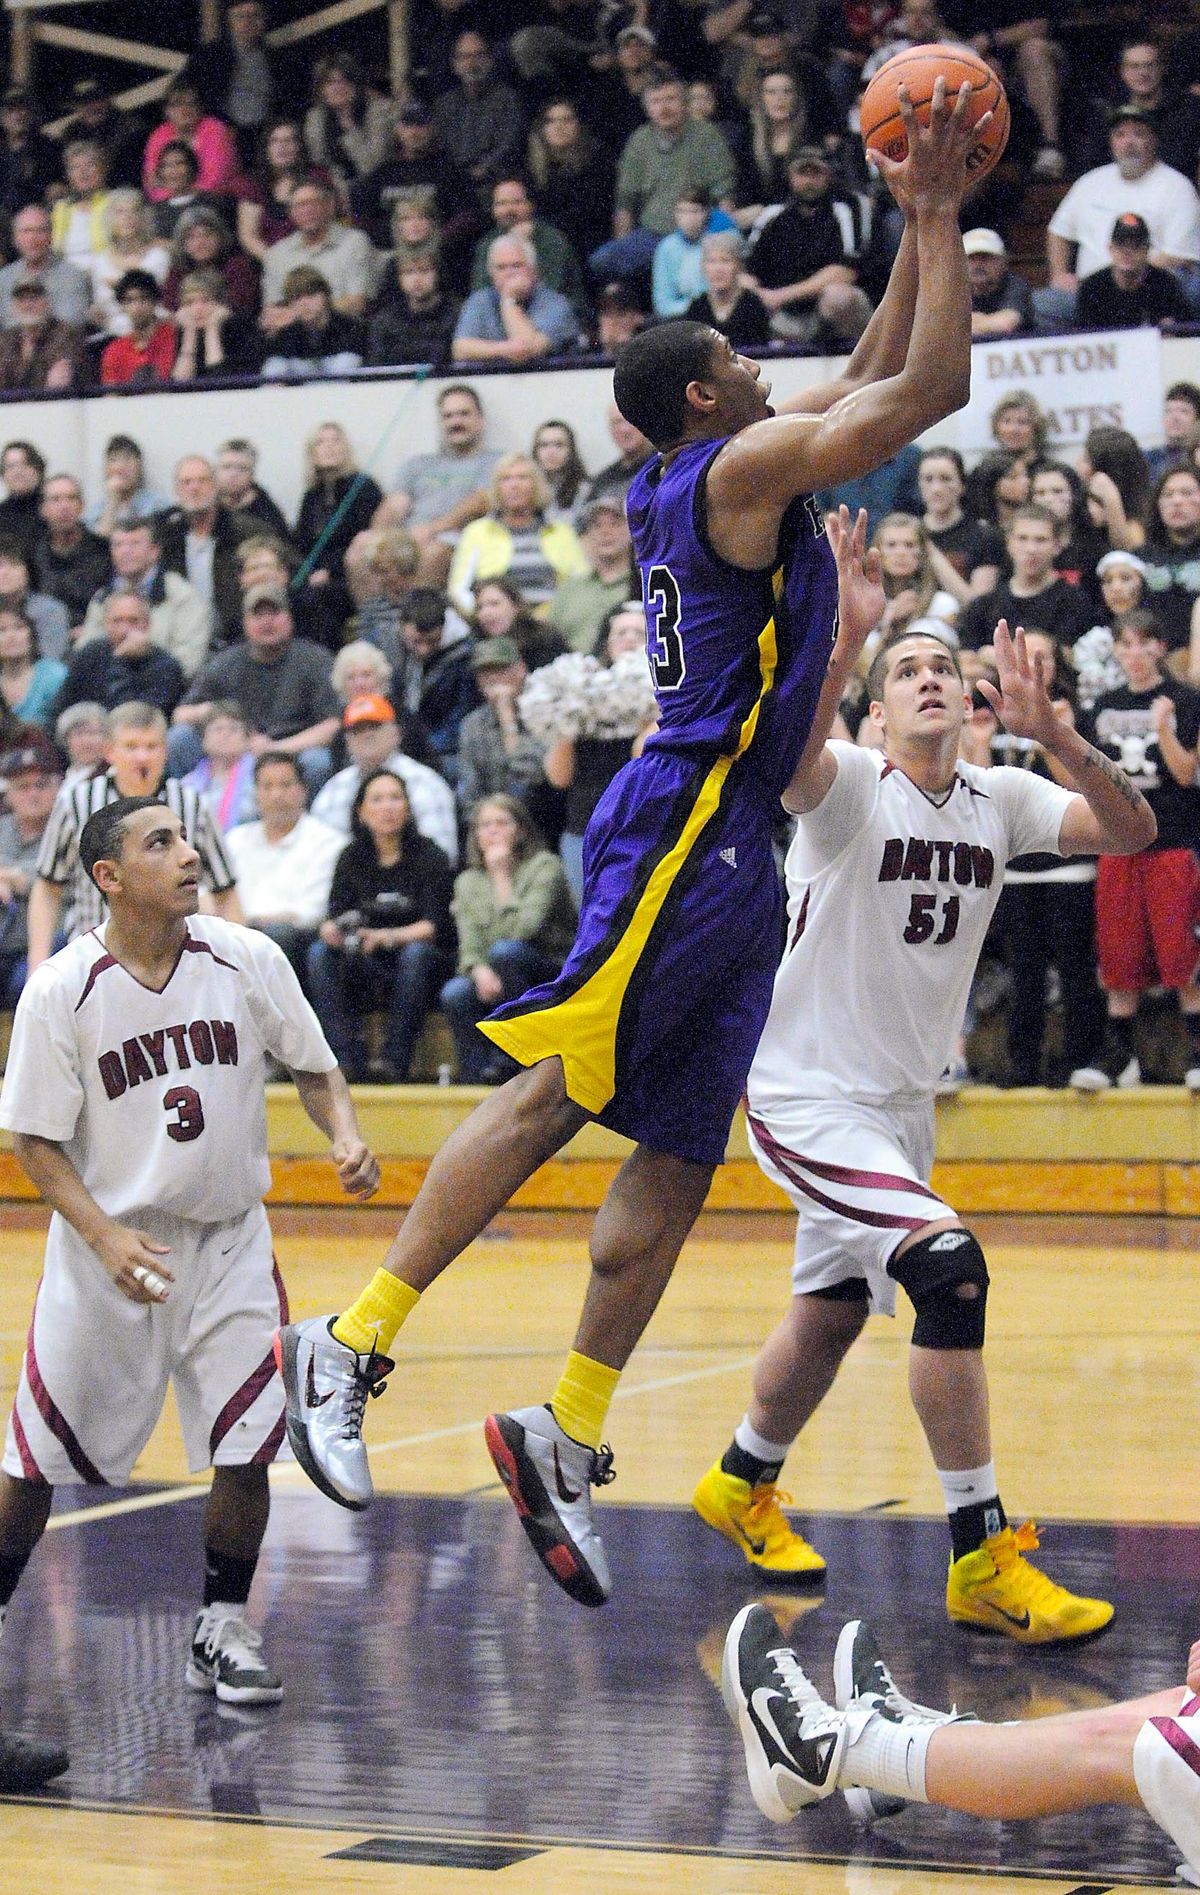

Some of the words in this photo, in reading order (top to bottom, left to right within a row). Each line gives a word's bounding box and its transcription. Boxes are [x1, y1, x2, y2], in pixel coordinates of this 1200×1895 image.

[986, 343, 1117, 379] DAYTON
[639, 564, 686, 690] 3
[878, 837, 994, 889] DAYTON
[903, 893, 960, 945] 51
[97, 1019, 239, 1101] DAYTON
[162, 1085, 205, 1142] 3
